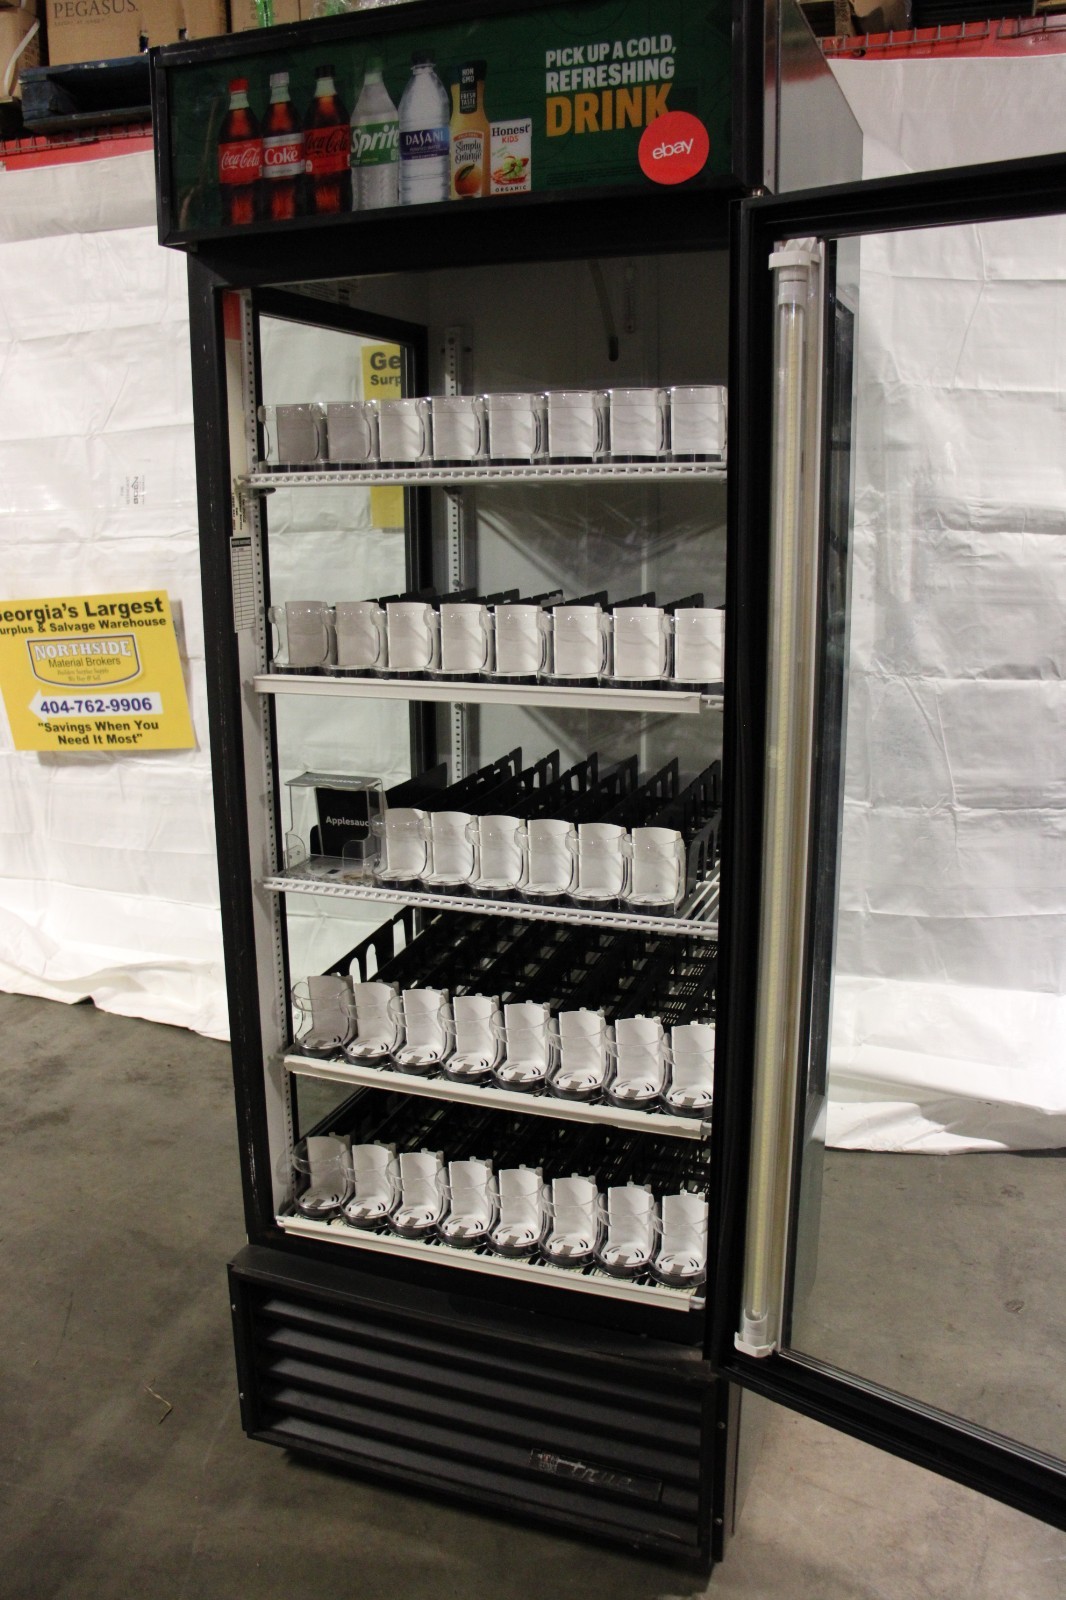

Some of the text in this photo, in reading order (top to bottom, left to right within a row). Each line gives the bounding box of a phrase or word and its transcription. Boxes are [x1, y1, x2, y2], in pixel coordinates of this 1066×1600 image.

[545, 33, 677, 68] PICK UP A COLD,
[462, 68, 475, 77] NON
[462, 76, 475, 84] GMO
[545, 57, 675, 94] REFRESHING
[545, 82, 673, 137] DRINK
[405, 130, 444, 147] DASANI
[491, 123, 531, 138] Honest
[455, 138, 482, 154] Simply
[501, 135, 519, 144] KIDS
[264, 148, 299, 166] Coke
[652, 138, 695, 160] ebay
[494, 184, 527, 193] ORGANIC
[84, 597, 164, 619] Largest
[0, 616, 167, 637] urplus & Salvage Warehouse
[33, 641, 133, 662] NORTHSIDE
[48, 656, 121, 668] Material Brokers
[40, 697, 153, 714] 404-762-9906
[38, 717, 159, 734] "Savings When You
[57, 733, 144, 745] Need It Most"
